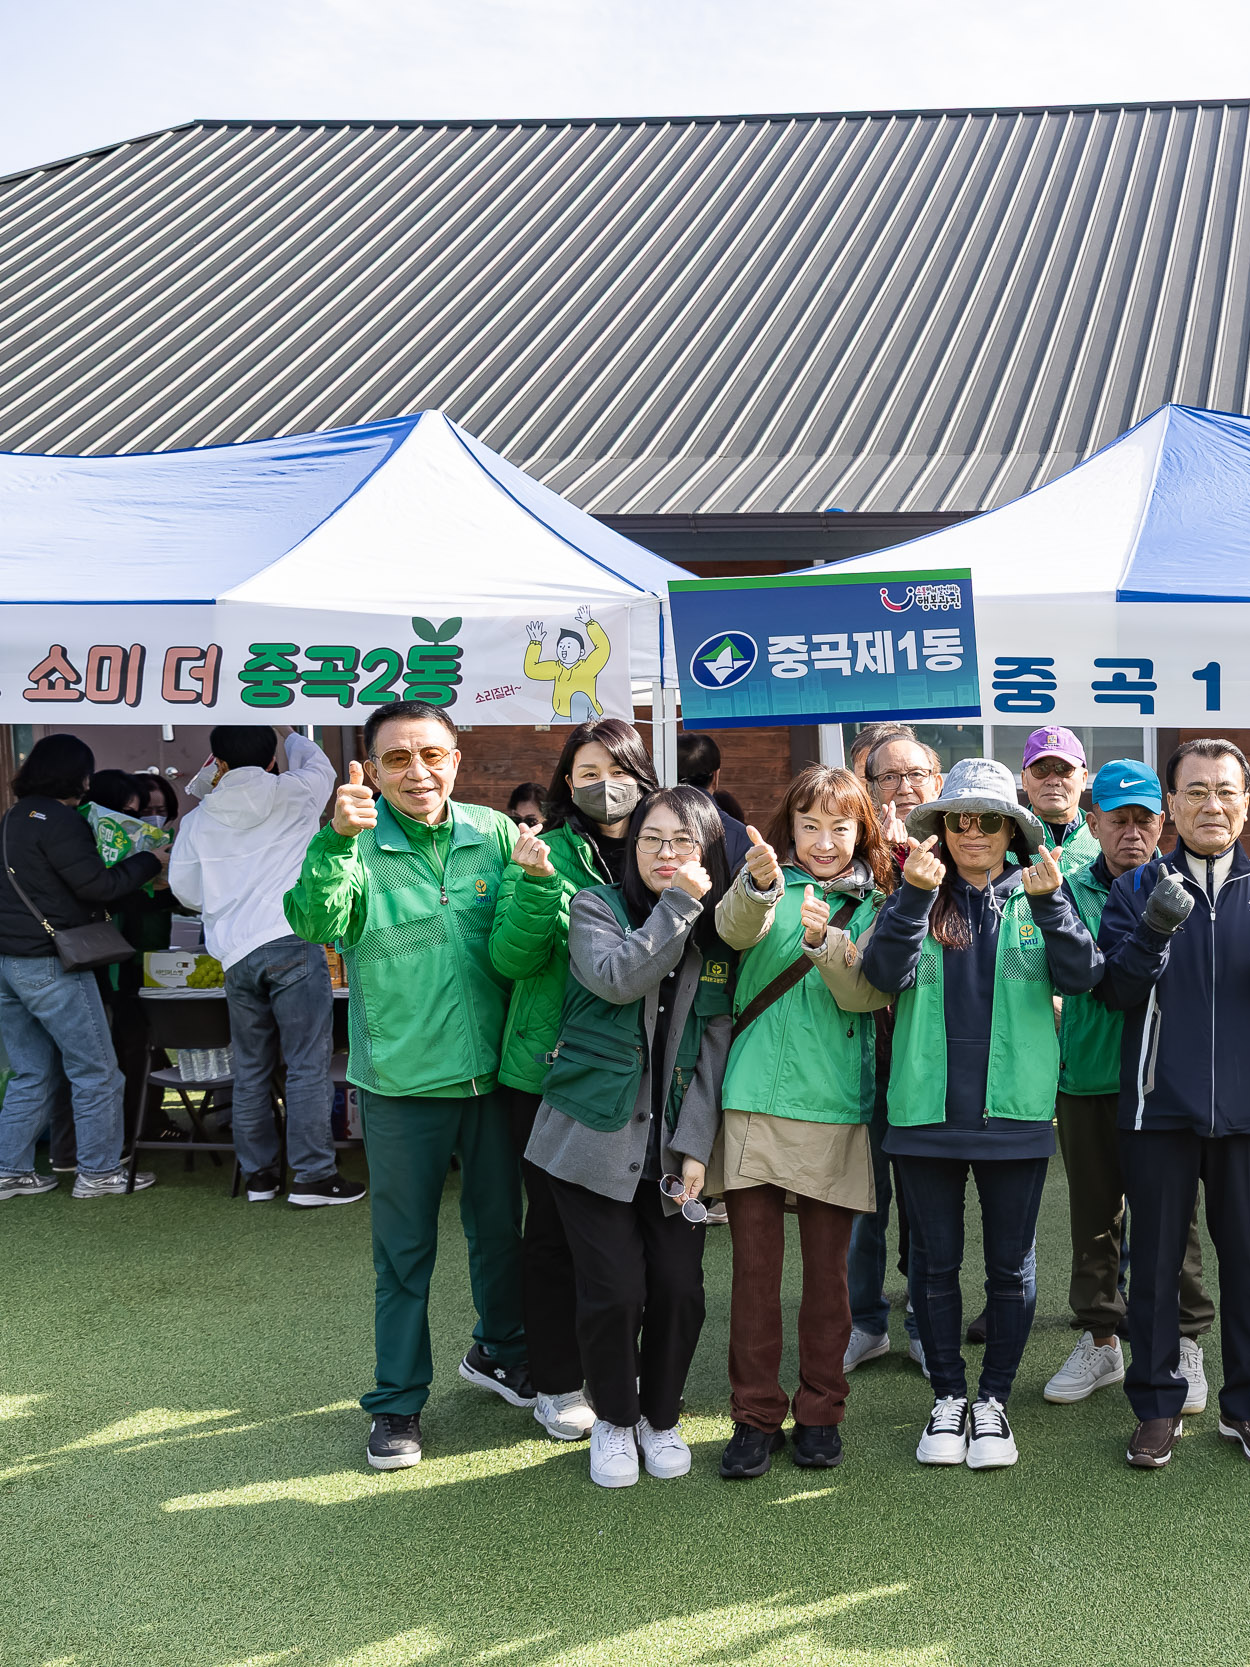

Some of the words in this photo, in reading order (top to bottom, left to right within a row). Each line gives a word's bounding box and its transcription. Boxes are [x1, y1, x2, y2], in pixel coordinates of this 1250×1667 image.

[916, 594, 960, 610] 행복광진
[767, 628, 964, 679] 중곡제1동
[23, 643, 147, 708] 쇼미
[161, 643, 223, 708] 더
[238, 642, 464, 708] 중곡2동
[475, 684, 522, 704] 소리질러~
